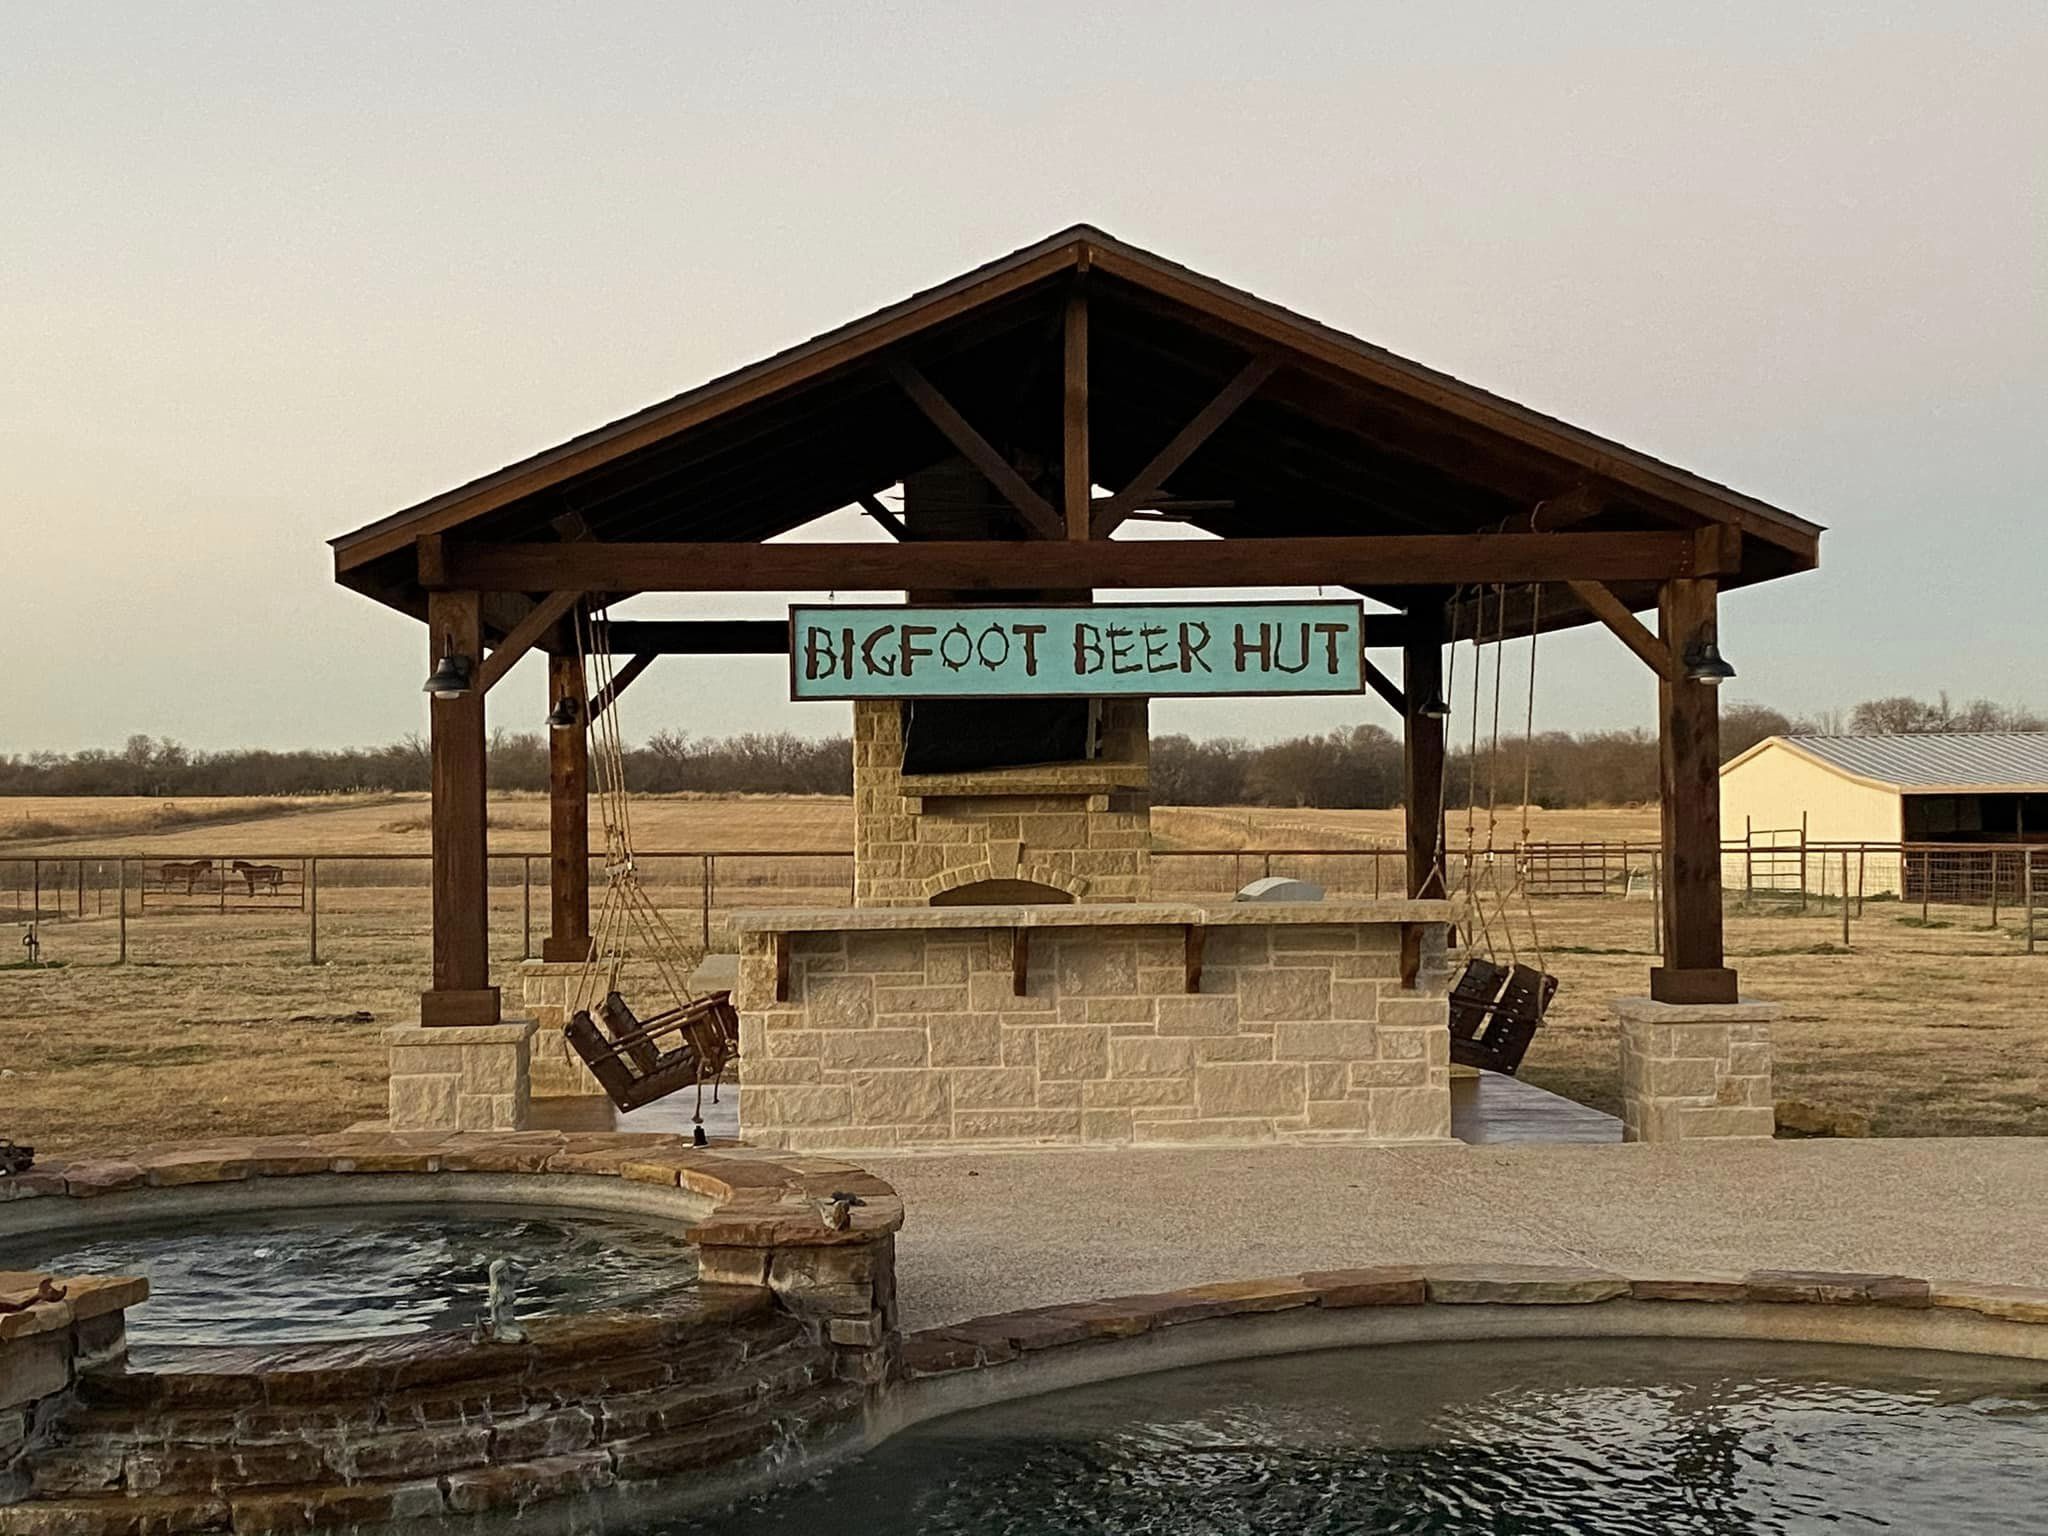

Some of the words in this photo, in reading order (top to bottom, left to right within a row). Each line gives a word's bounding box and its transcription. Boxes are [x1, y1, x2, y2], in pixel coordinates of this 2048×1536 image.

[805, 622, 1047, 680] BIGFOOT
[1073, 621, 1213, 675] BEER
[1233, 622, 1350, 674] HUT
